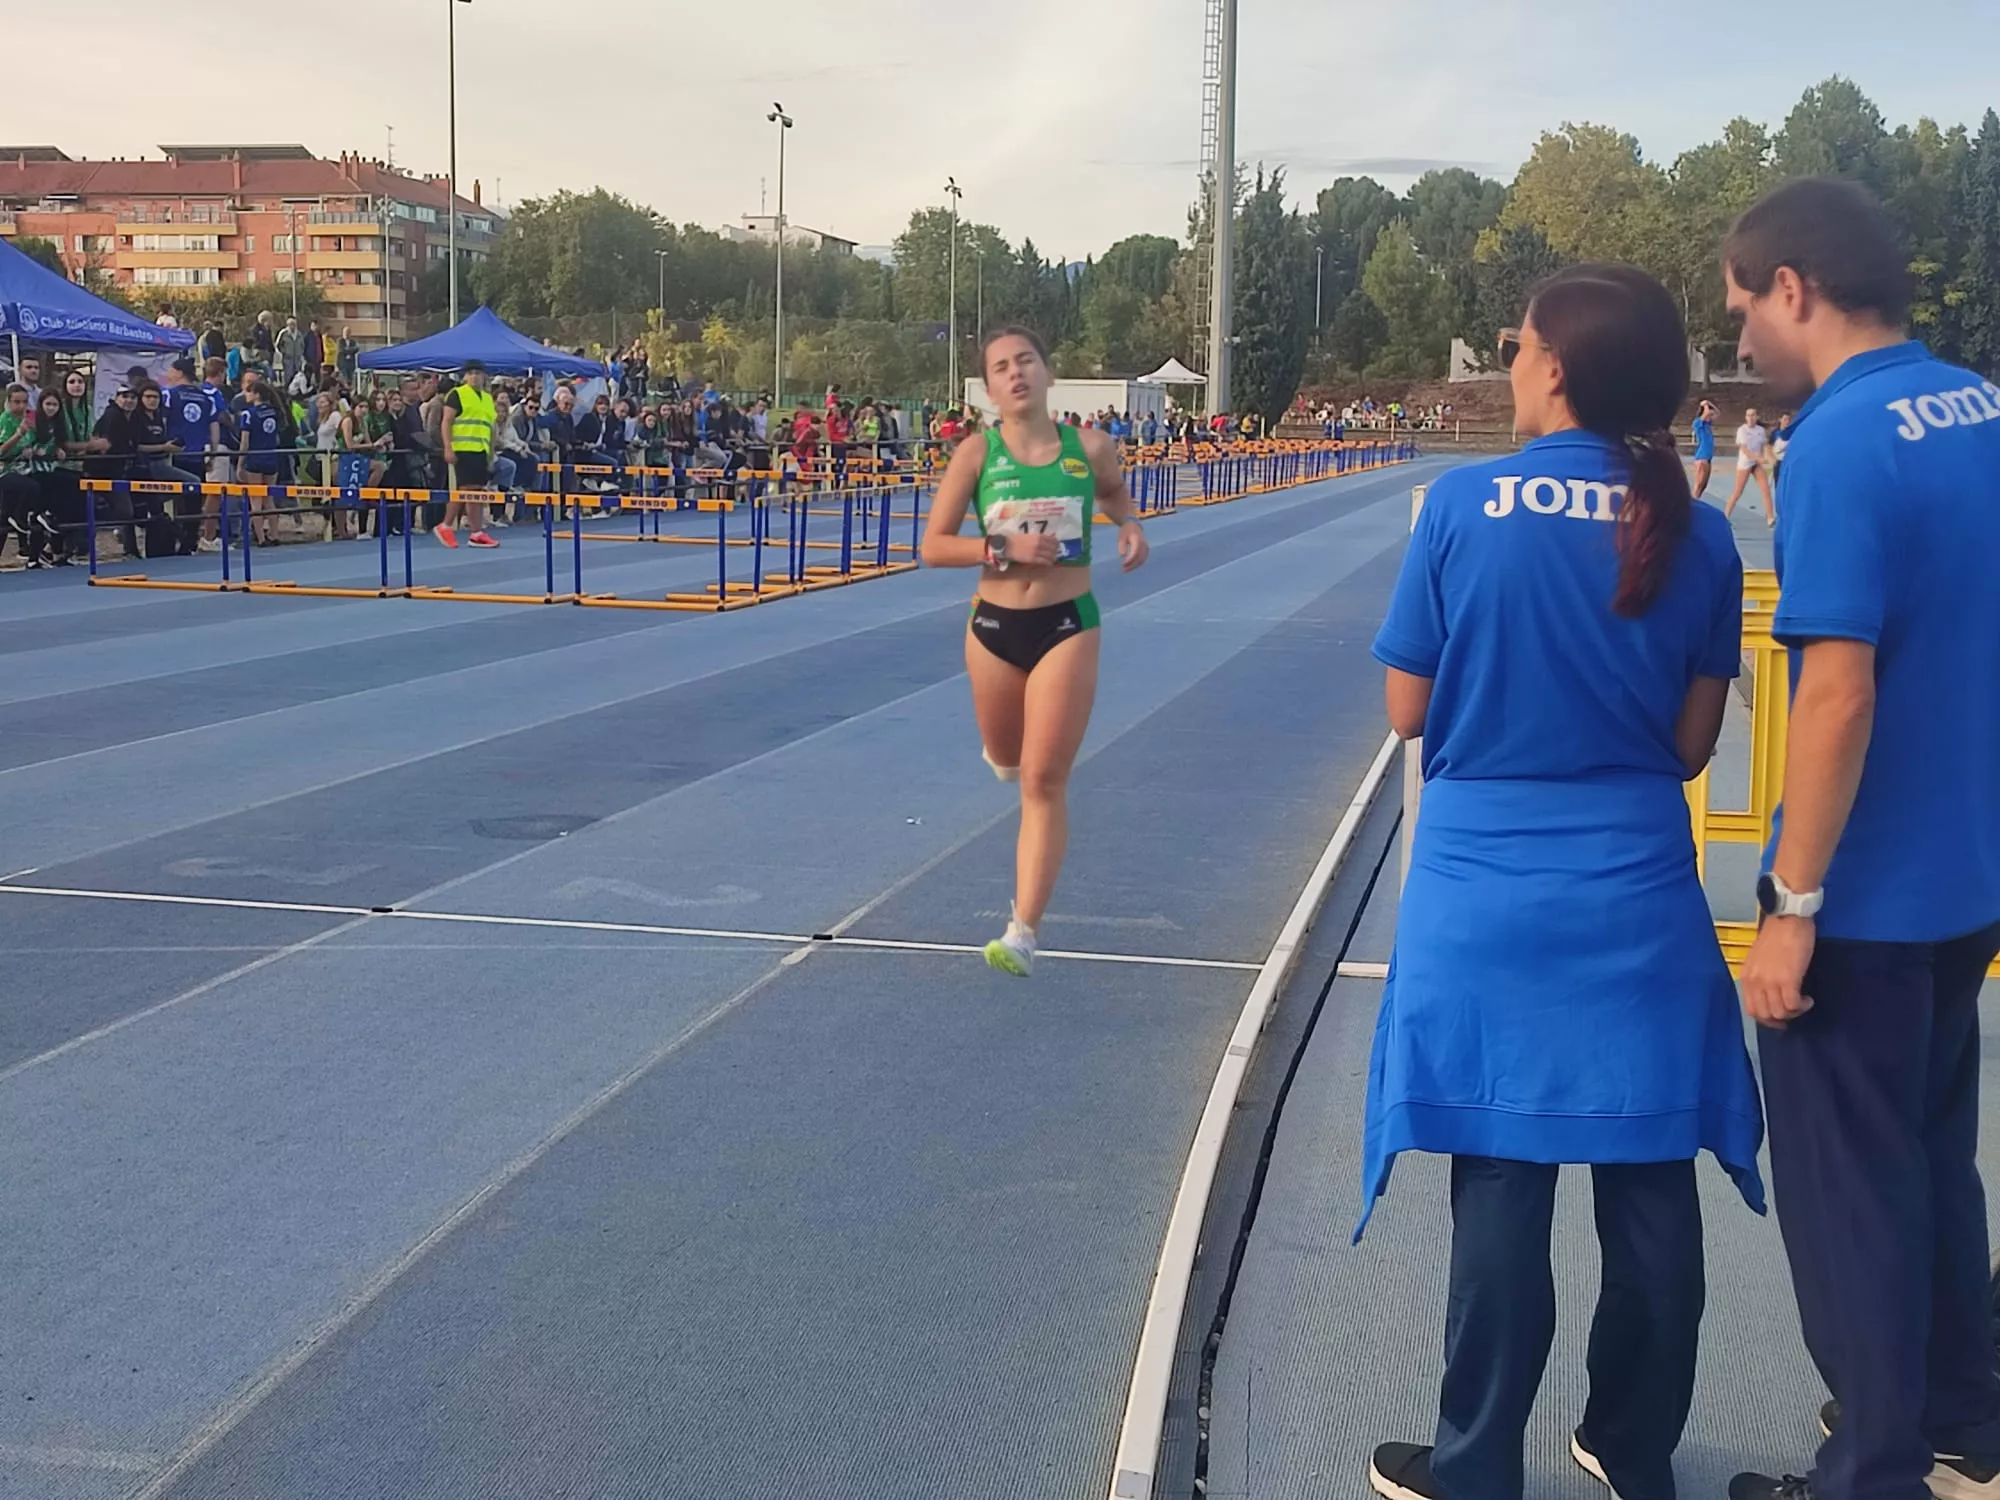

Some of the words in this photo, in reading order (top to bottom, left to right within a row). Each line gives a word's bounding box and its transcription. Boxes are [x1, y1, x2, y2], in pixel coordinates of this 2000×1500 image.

[40, 316, 64, 328] Club
[630, 499, 668, 508] MONDO
[1484, 476, 1635, 522] Jom
[1019, 520, 1049, 534] 17
